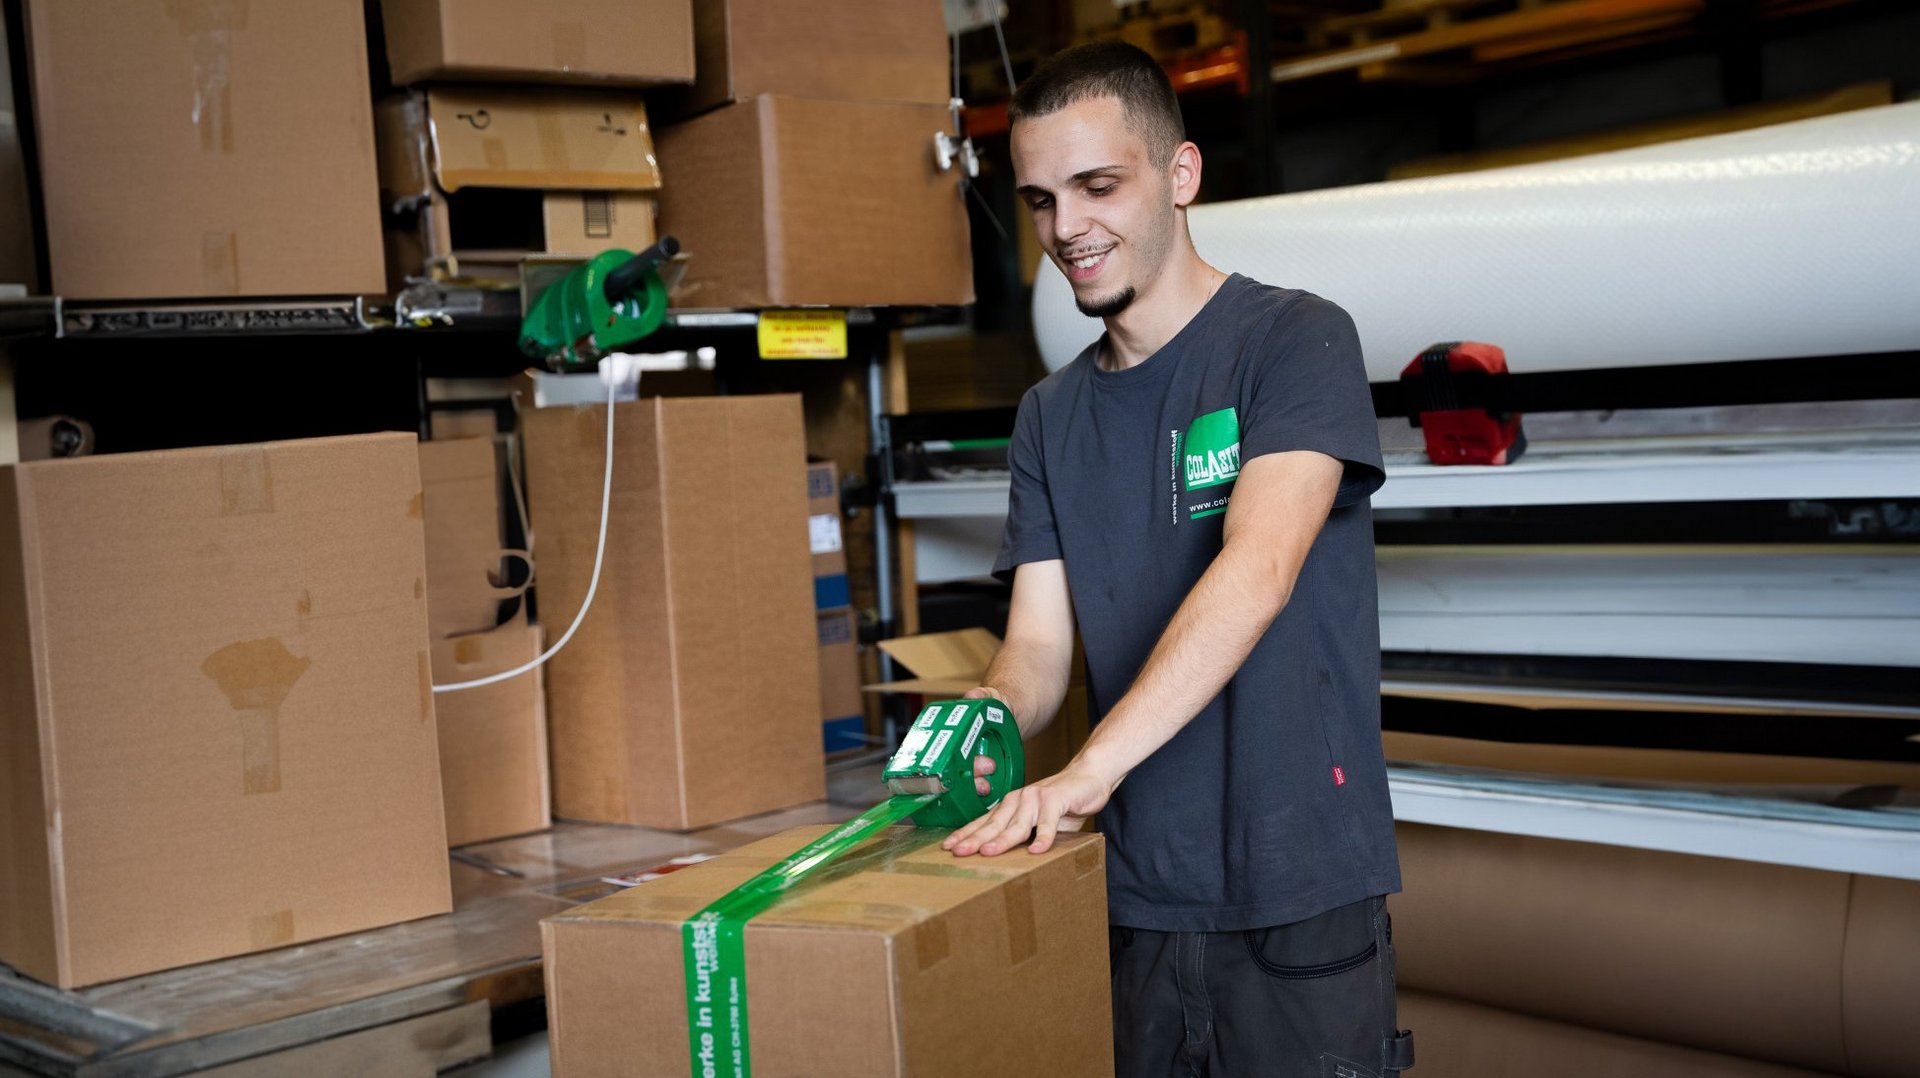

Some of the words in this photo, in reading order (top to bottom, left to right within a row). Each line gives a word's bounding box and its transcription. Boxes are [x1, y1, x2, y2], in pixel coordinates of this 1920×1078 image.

[1186, 442, 1240, 482] COLASIT
[1172, 482, 1177, 492] in
[696, 1007, 712, 1028] in
